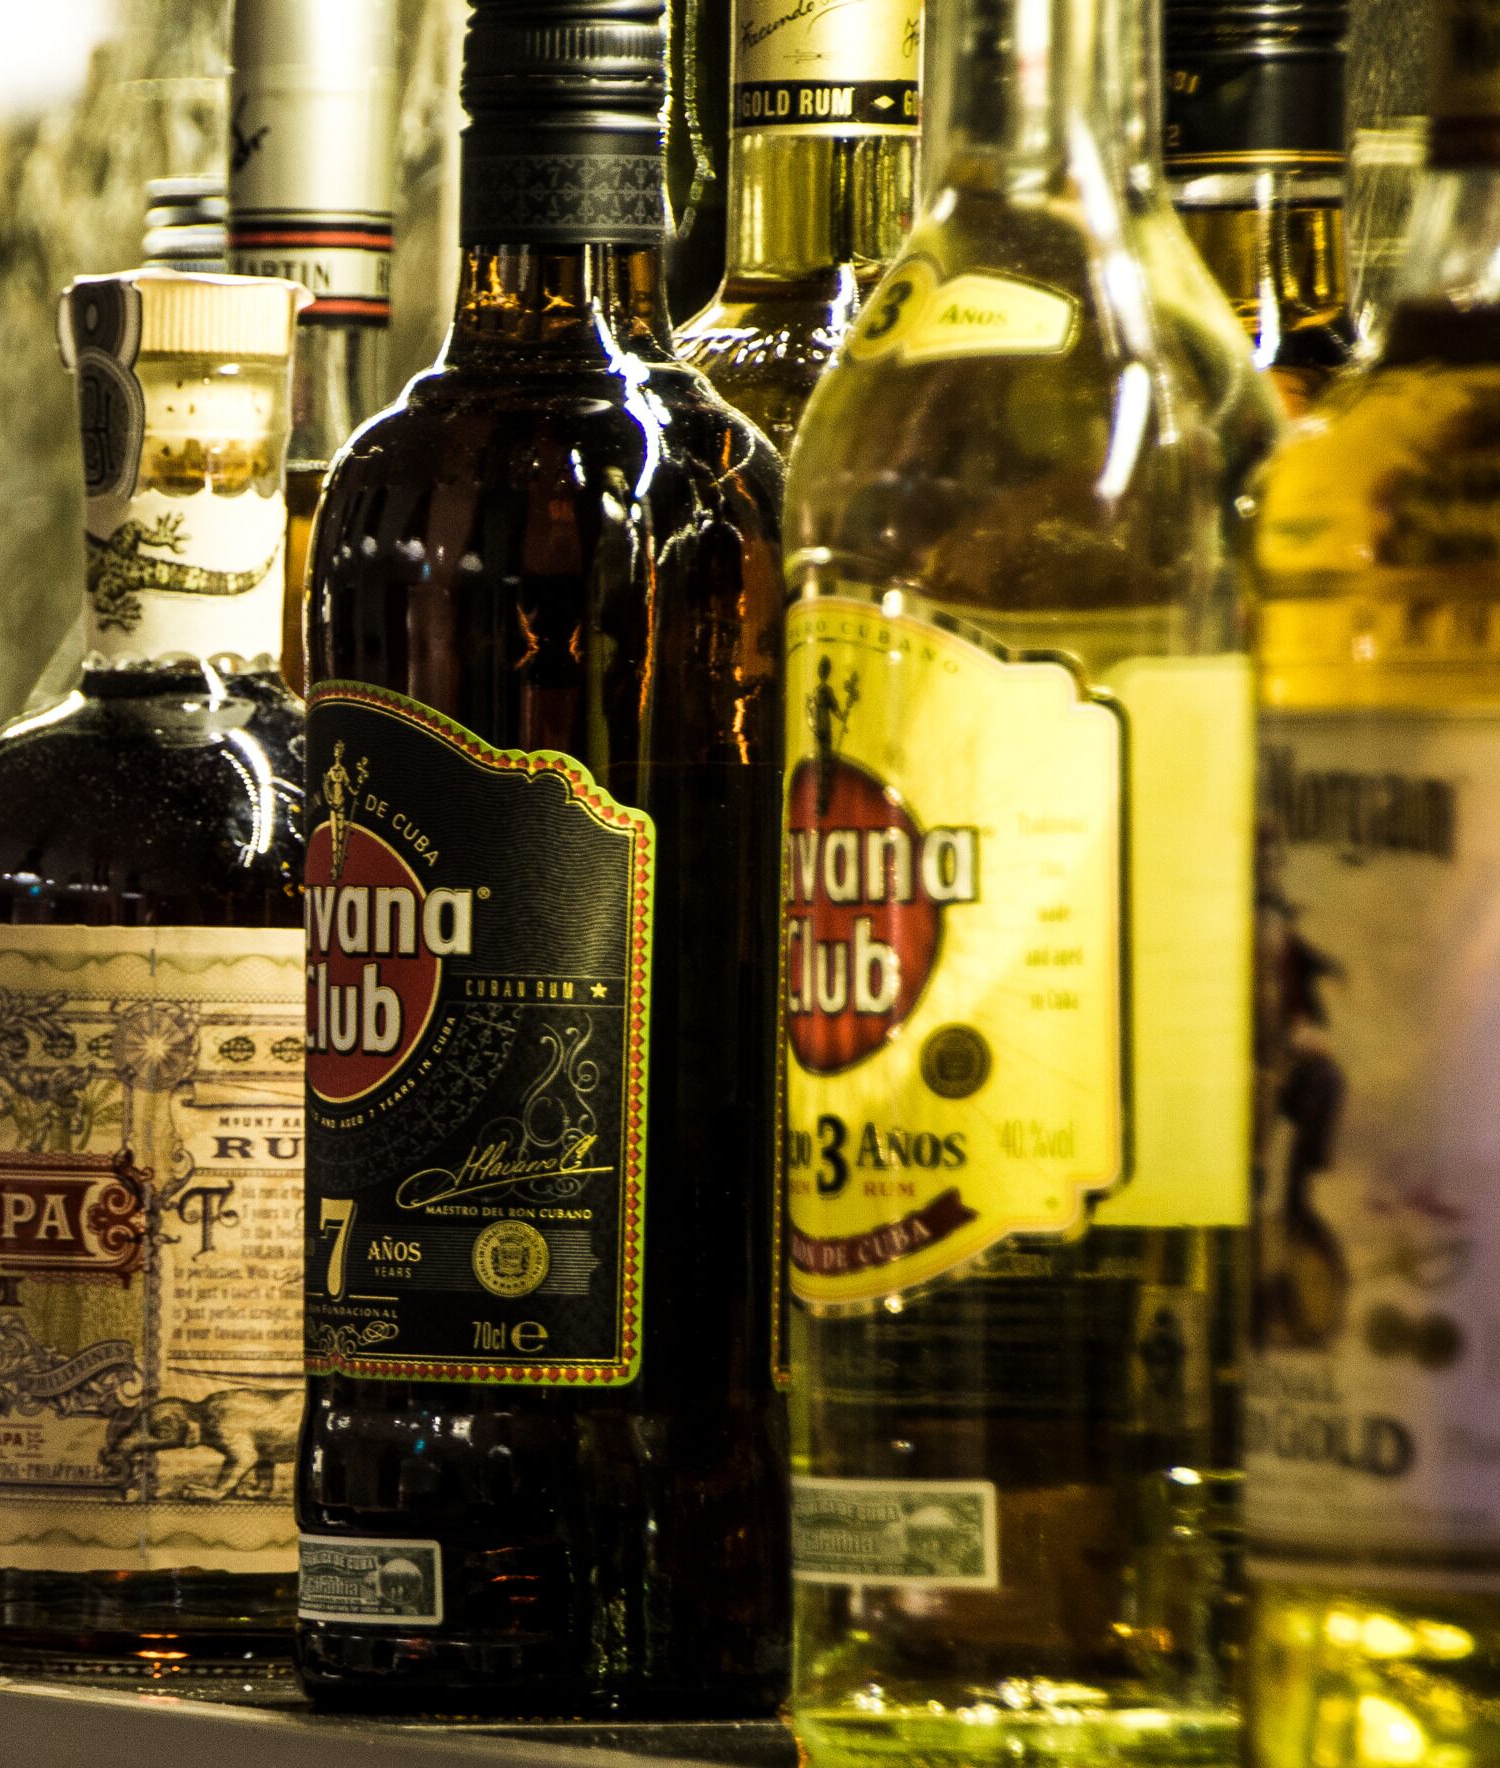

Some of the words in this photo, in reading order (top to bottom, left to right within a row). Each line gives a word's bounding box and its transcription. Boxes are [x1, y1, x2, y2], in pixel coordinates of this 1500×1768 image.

[741, 88, 790, 118] GOLD
[799, 87, 853, 117] RUM
[864, 279, 914, 341] 3
[365, 793, 389, 818] DE
[391, 813, 439, 868] CUBA
[786, 826, 982, 903] vana
[305, 885, 473, 957] vana
[465, 981, 526, 998] CUBAN
[537, 982, 575, 1000] RUM
[378, 1076, 417, 1112] YEARS
[418, 1058, 433, 1075] IN
[432, 1015, 456, 1053] CUBA
[219, 1116, 273, 1128] MOUNT
[816, 1113, 849, 1196] 3
[177, 1179, 240, 1263] T
[425, 1204, 478, 1217] MAESTRO
[482, 1205, 504, 1218] DEL
[509, 1206, 536, 1219] RON
[539, 1207, 593, 1220] CUBANO
[319, 1197, 356, 1300] 7
[367, 1235, 422, 1263] AÑOS
[858, 1218, 932, 1264] CUBA
[374, 1267, 412, 1279] YEARS
[321, 1303, 399, 1319] FUNDACIONAL
[471, 1321, 507, 1350] 70cl
